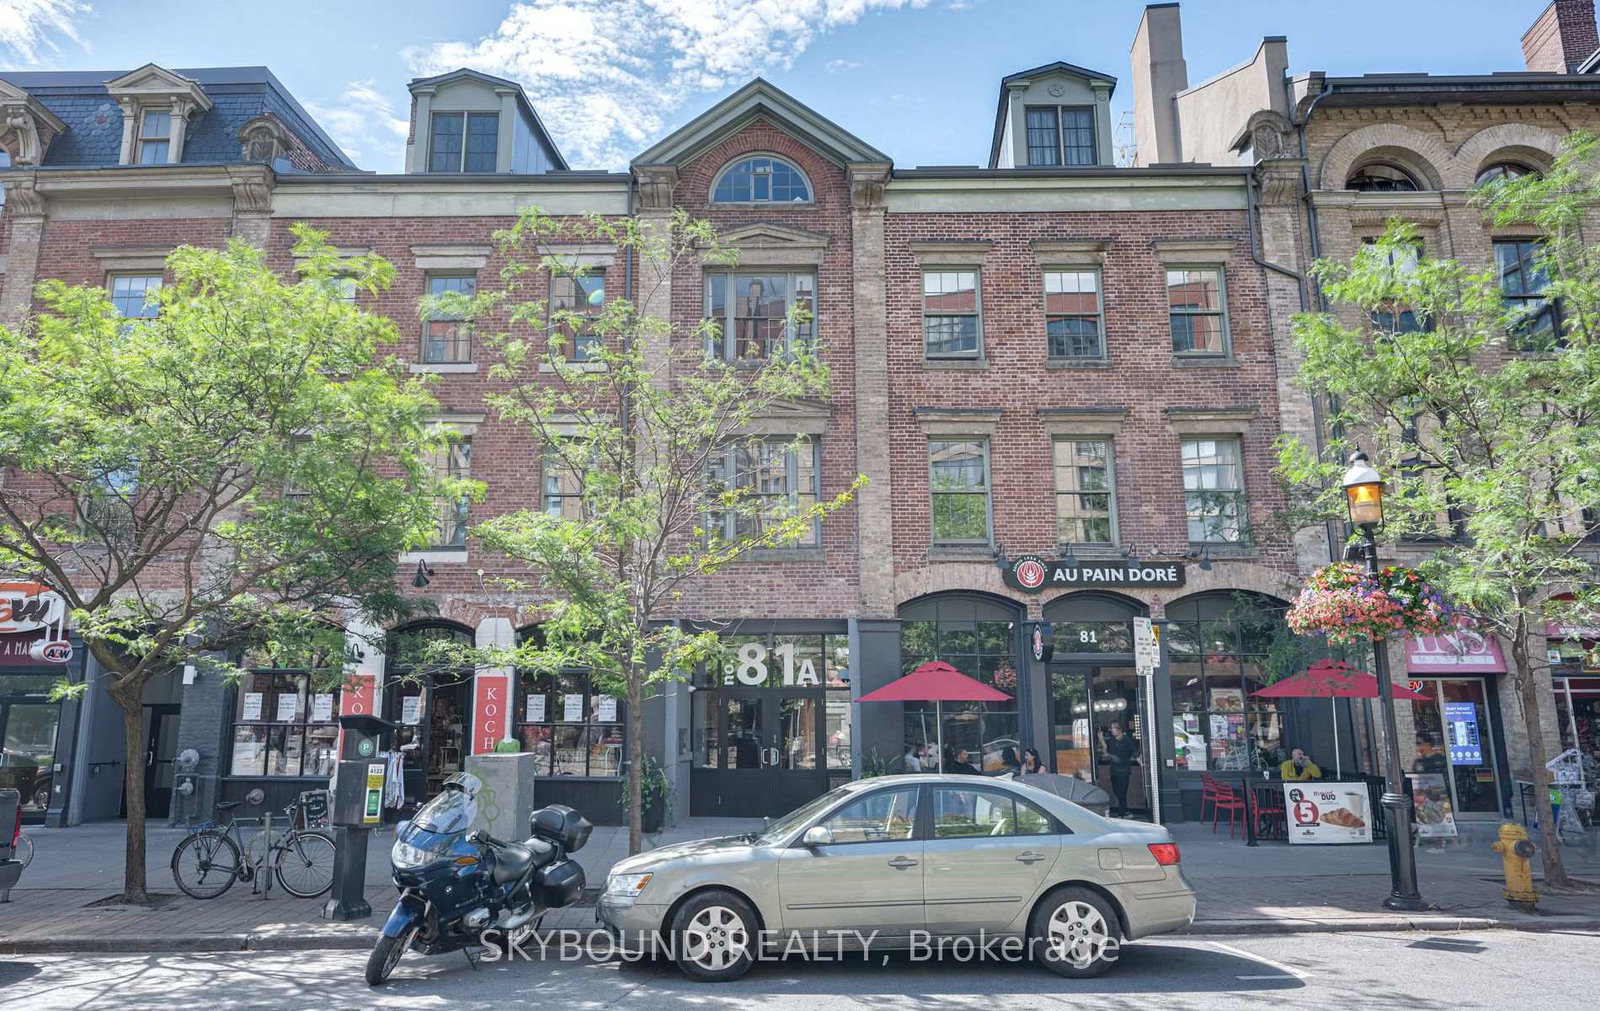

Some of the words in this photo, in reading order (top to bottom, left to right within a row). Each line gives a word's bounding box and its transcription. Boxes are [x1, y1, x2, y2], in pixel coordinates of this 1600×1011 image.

[1053, 568, 1078, 581] AU
[1082, 569, 1124, 581] PAIN
[1128, 566, 1177, 581] DORÉ
[1080, 631, 1097, 642] 81
[47, 648, 70, 658] A&W
[484, 687, 499, 749] KOCH
[1299, 803, 1314, 822] 5
